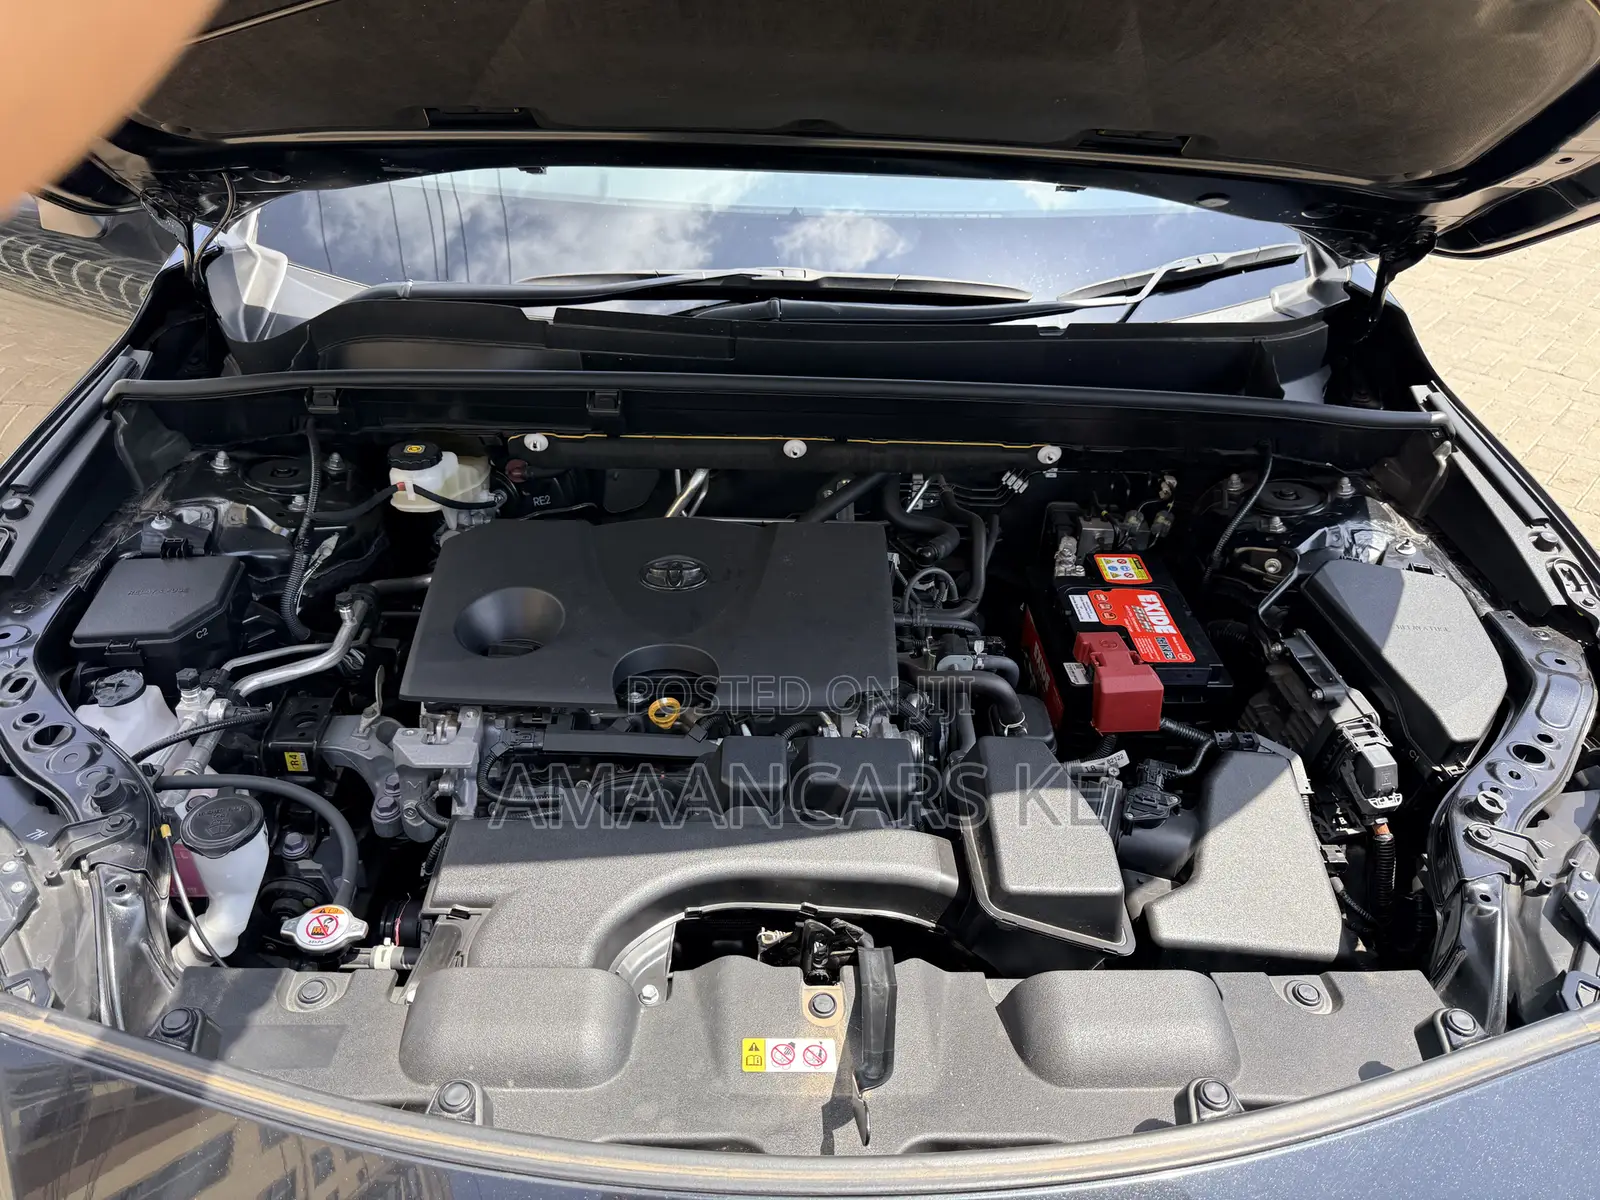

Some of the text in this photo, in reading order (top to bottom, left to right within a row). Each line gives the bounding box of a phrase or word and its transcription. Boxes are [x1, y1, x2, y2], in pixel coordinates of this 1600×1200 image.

[532, 494, 551, 507] RE2
[1137, 594, 1177, 634] EXIDE
[195, 627, 209, 640] C2
